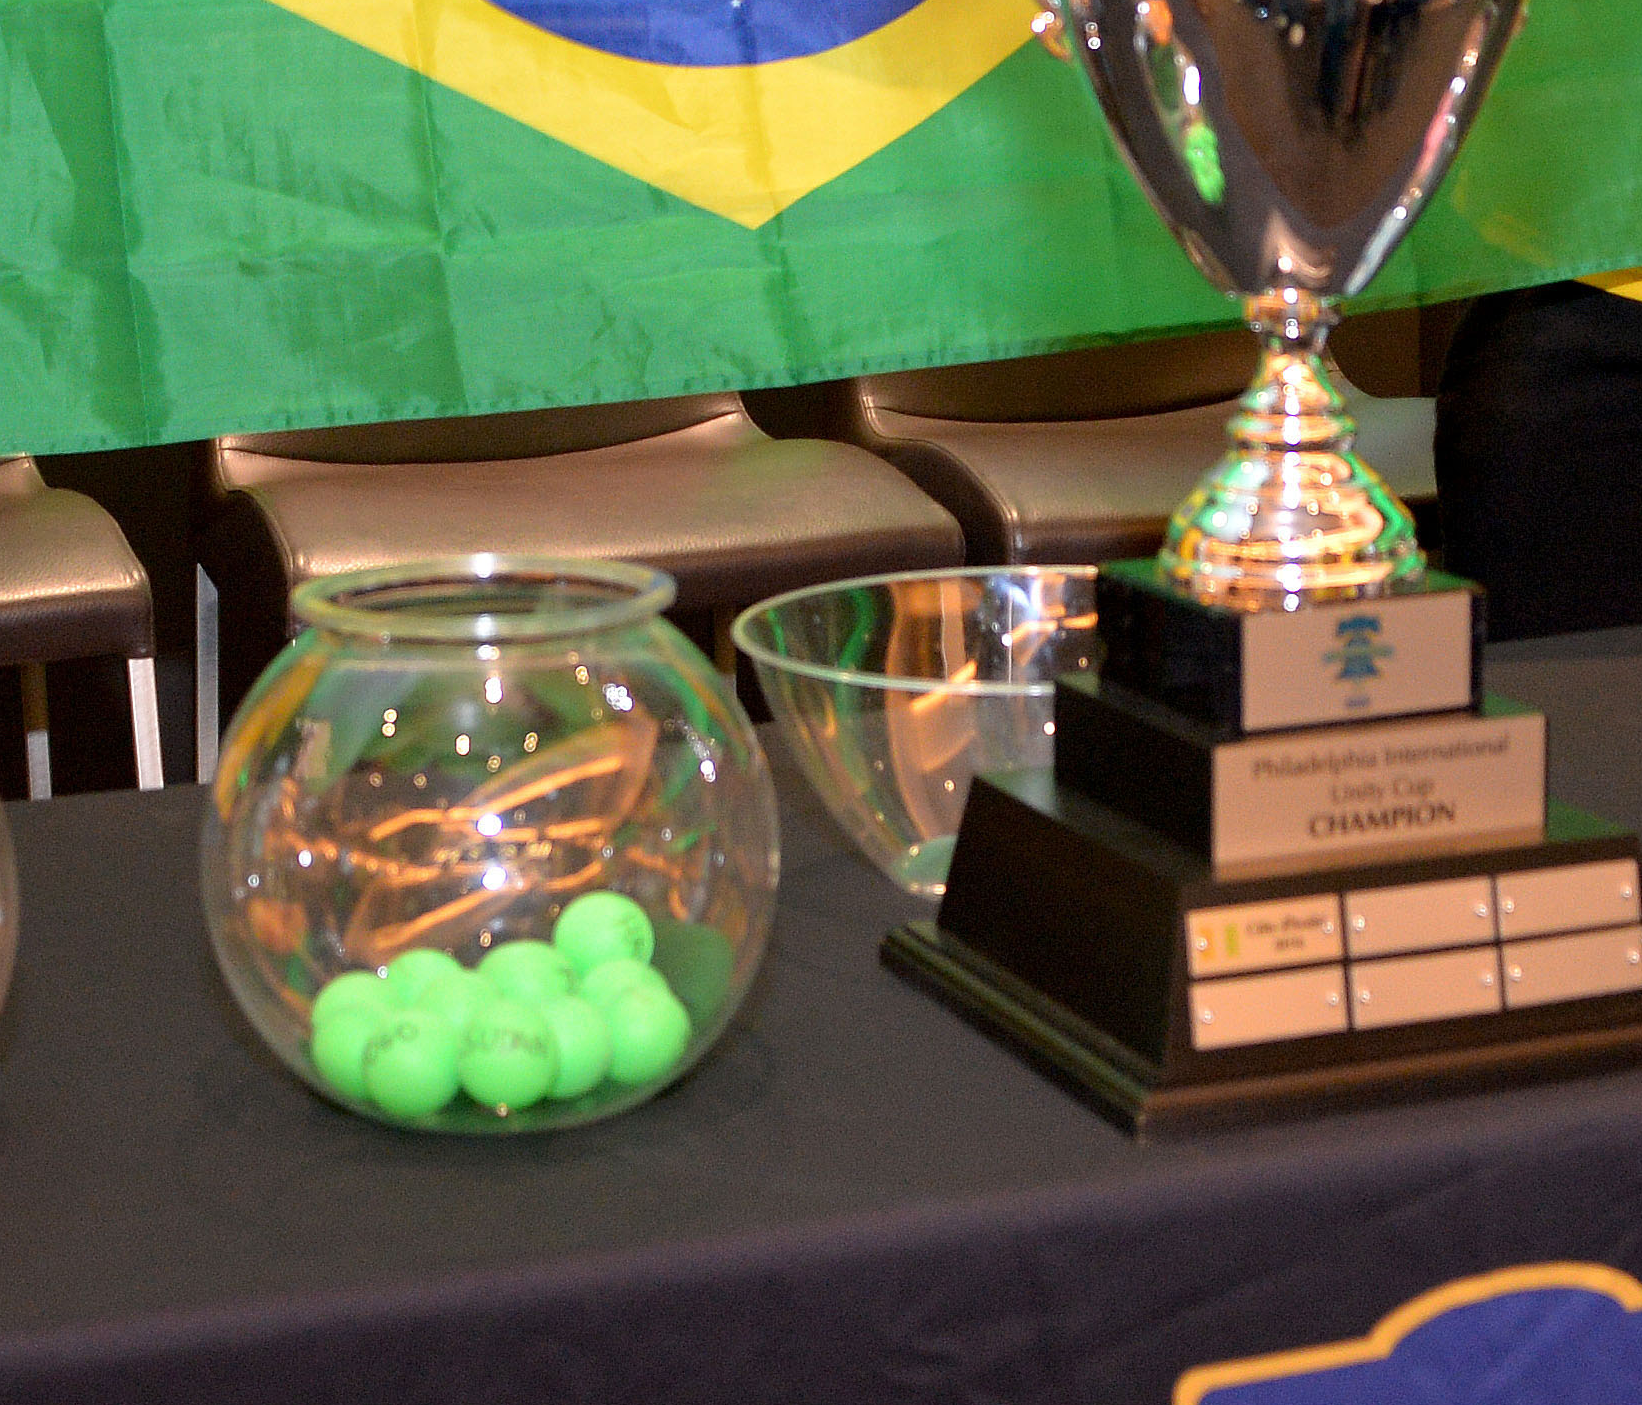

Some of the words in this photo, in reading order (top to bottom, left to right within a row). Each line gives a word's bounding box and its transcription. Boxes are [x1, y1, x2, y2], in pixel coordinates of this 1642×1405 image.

[1253, 748, 1377, 778] Philadelphia
[1385, 734, 1510, 766] International
[1330, 781, 1385, 804] Unity
[1392, 777, 1435, 800] Cup
[1308, 801, 1456, 838] CHAMPION
